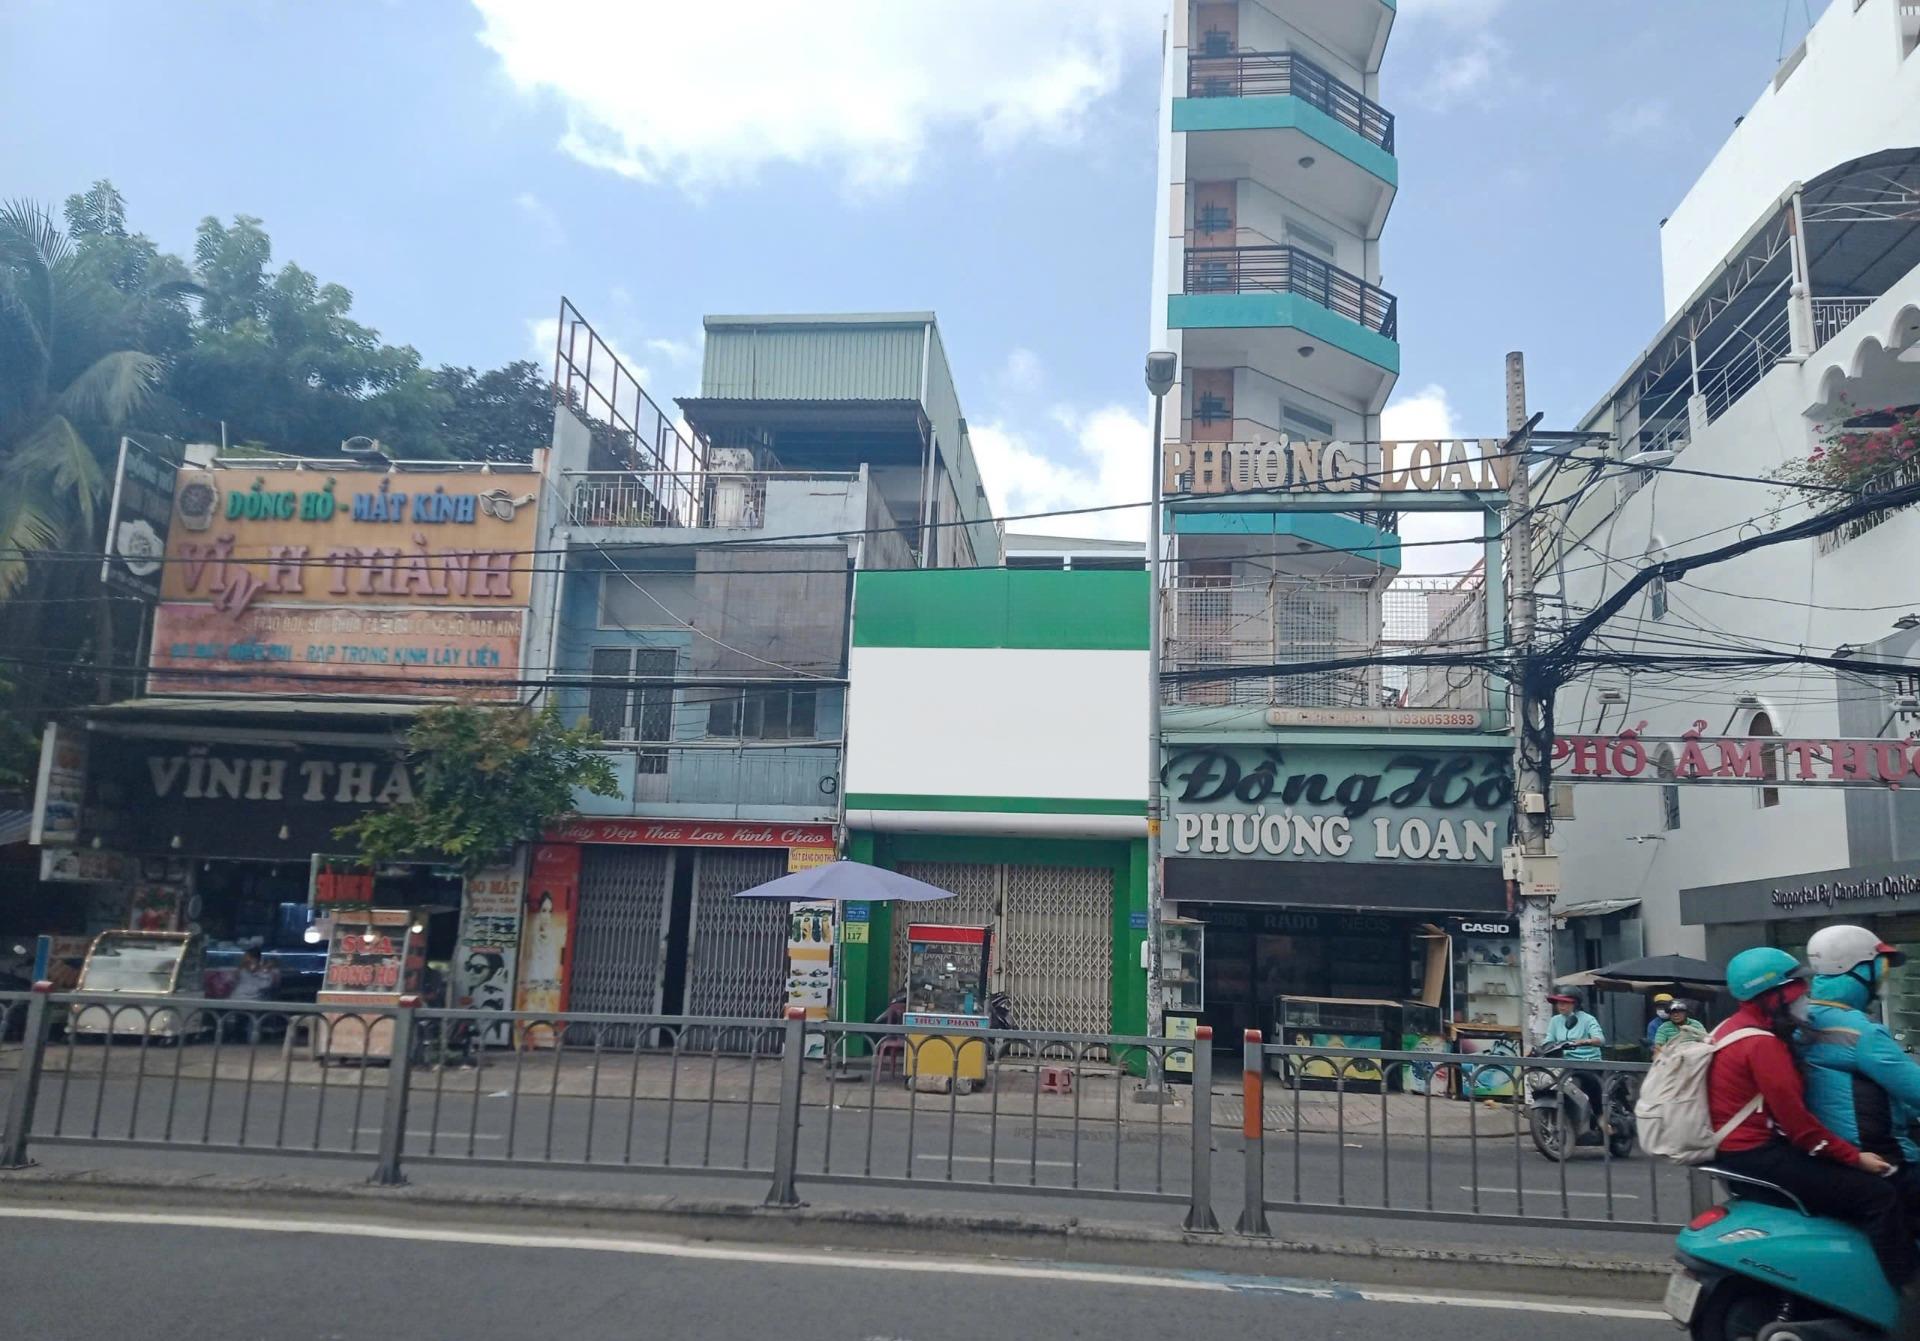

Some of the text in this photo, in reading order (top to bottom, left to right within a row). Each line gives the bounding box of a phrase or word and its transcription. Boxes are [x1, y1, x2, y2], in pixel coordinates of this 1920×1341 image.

[1163, 432, 1511, 494] PHƯƠNG LOAN
[411, 485, 477, 524] KÍNH
[327, 532, 517, 597] THÀNH
[148, 746, 287, 801] VĨNH
[1160, 746, 1517, 819] Đồng Hồ
[1674, 718, 1766, 779] ẨM
[1786, 735, 1920, 792] THỰ
[644, 825, 683, 840] Thái
[688, 827, 725, 841] Lan
[731, 826, 774, 843] Kính
[781, 827, 826, 843] Chào
[1175, 804, 1497, 861] PHƯƠNG LOAN
[1771, 884, 1820, 911] Supported
[1833, 879, 1883, 901] Canadian
[1461, 922, 1510, 934] CASIO
